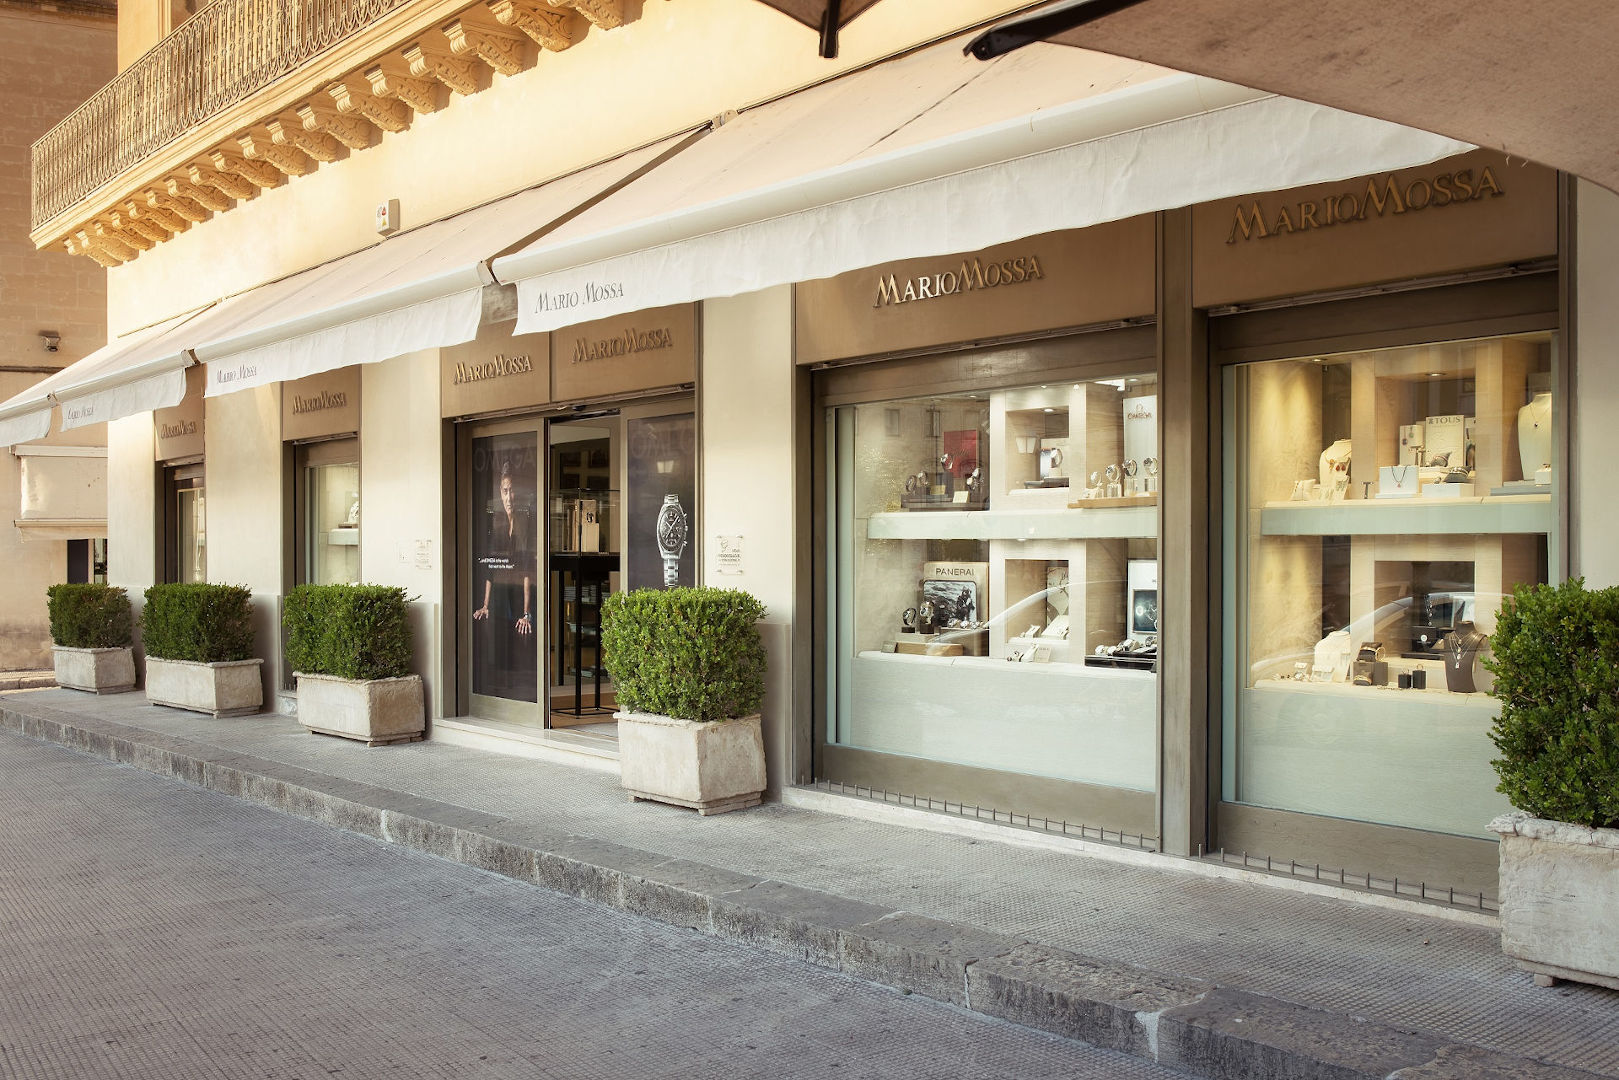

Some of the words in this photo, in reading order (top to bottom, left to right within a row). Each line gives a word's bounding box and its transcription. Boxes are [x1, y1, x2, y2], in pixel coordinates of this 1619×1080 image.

[534, 290, 579, 314] MARIO
[582, 281, 624, 305] MOSSA
[1434, 415, 1461, 425] TOUS
[935, 567, 975, 576] PANERAI
